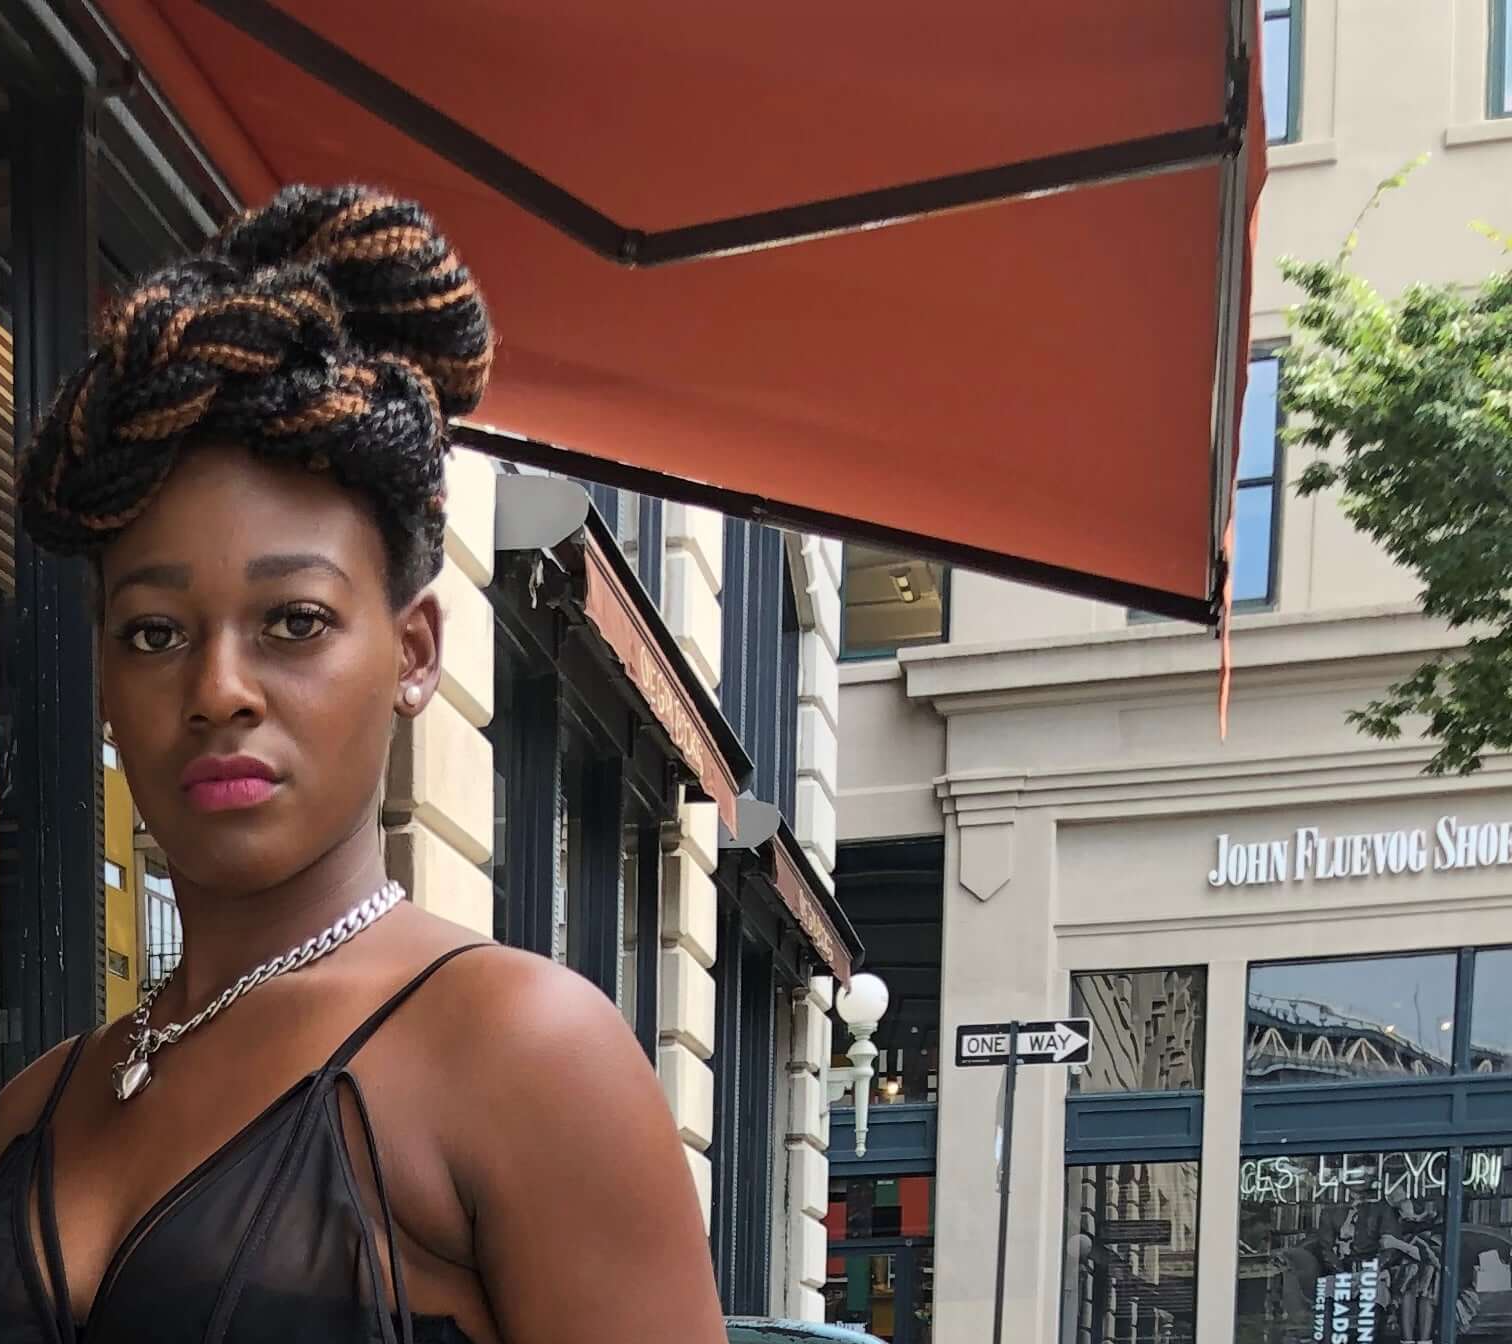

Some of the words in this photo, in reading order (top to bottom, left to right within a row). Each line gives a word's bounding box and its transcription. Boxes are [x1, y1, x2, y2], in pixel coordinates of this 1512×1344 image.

[1208, 833, 1289, 886] JOHN
[1294, 826, 1427, 881] FLUEVOG
[967, 1036, 1007, 1054] ONE
[1028, 1034, 1072, 1052] WAY
[1315, 1277, 1327, 1311] SINCE
[1313, 1313, 1325, 1341] 1970
